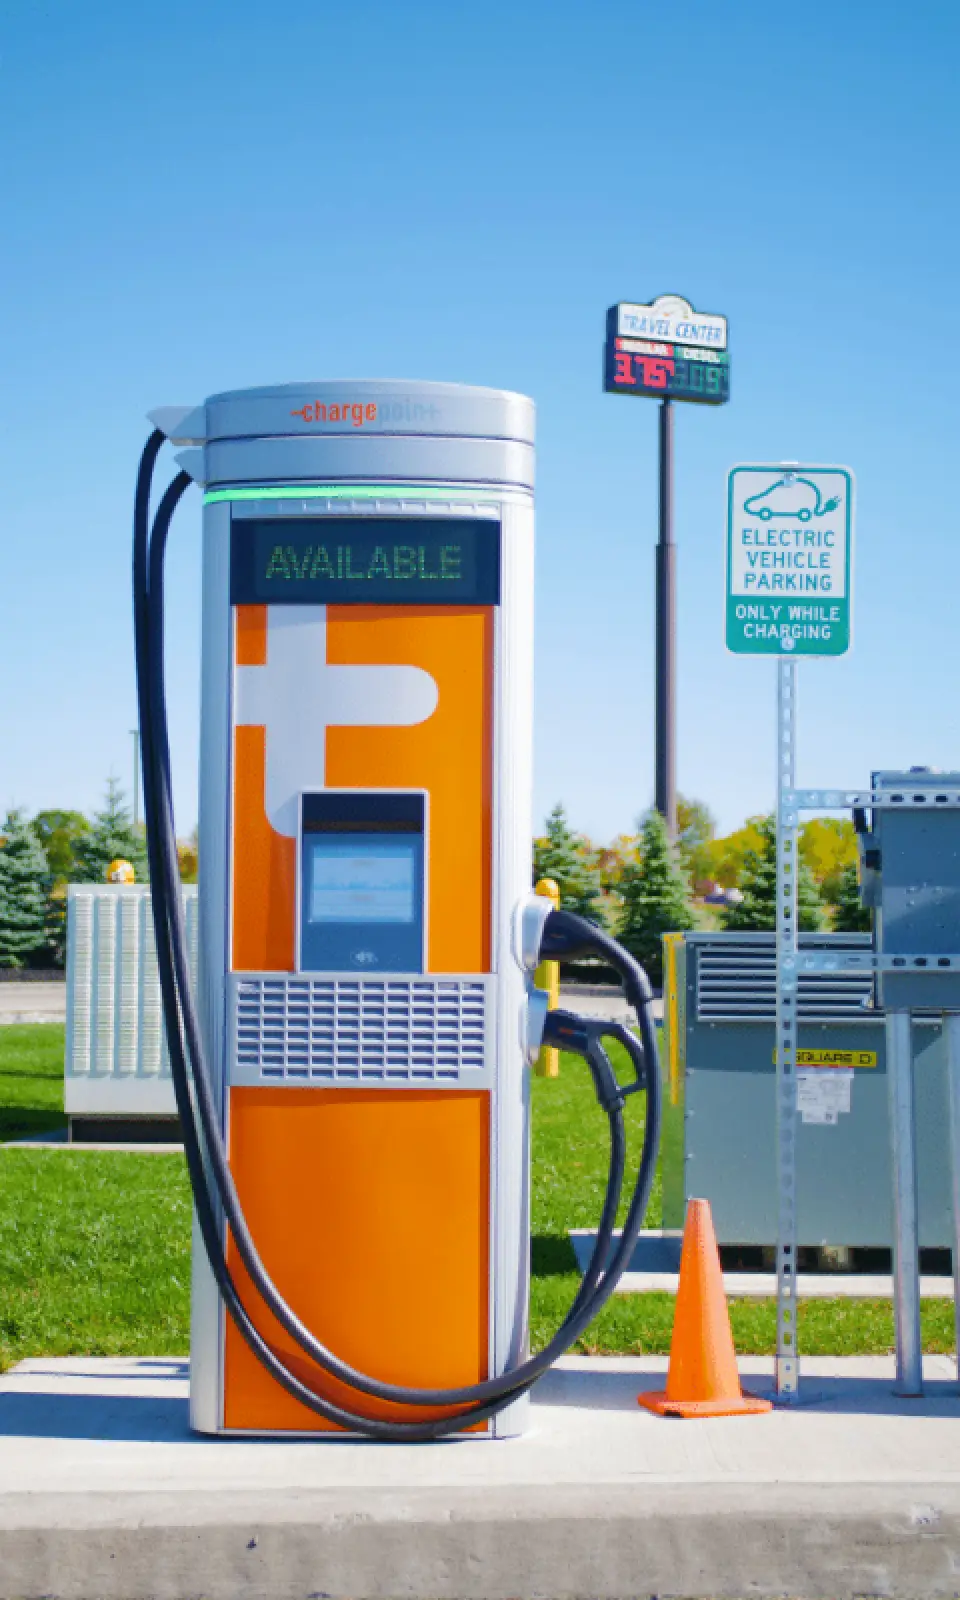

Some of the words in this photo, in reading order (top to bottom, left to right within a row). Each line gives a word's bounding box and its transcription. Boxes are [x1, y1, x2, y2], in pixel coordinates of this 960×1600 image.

[676, 322, 722, 342] CENTER
[742, 528, 835, 547] ELECTRIC
[265, 545, 462, 579] AVAILABLE
[746, 550, 831, 569] VEHICLE
[743, 572, 833, 591] PARKING
[735, 604, 782, 619] ONLY
[788, 605, 841, 621] WHILE
[743, 623, 831, 639] CHARGING
[859, 1053, 872, 1064] D
